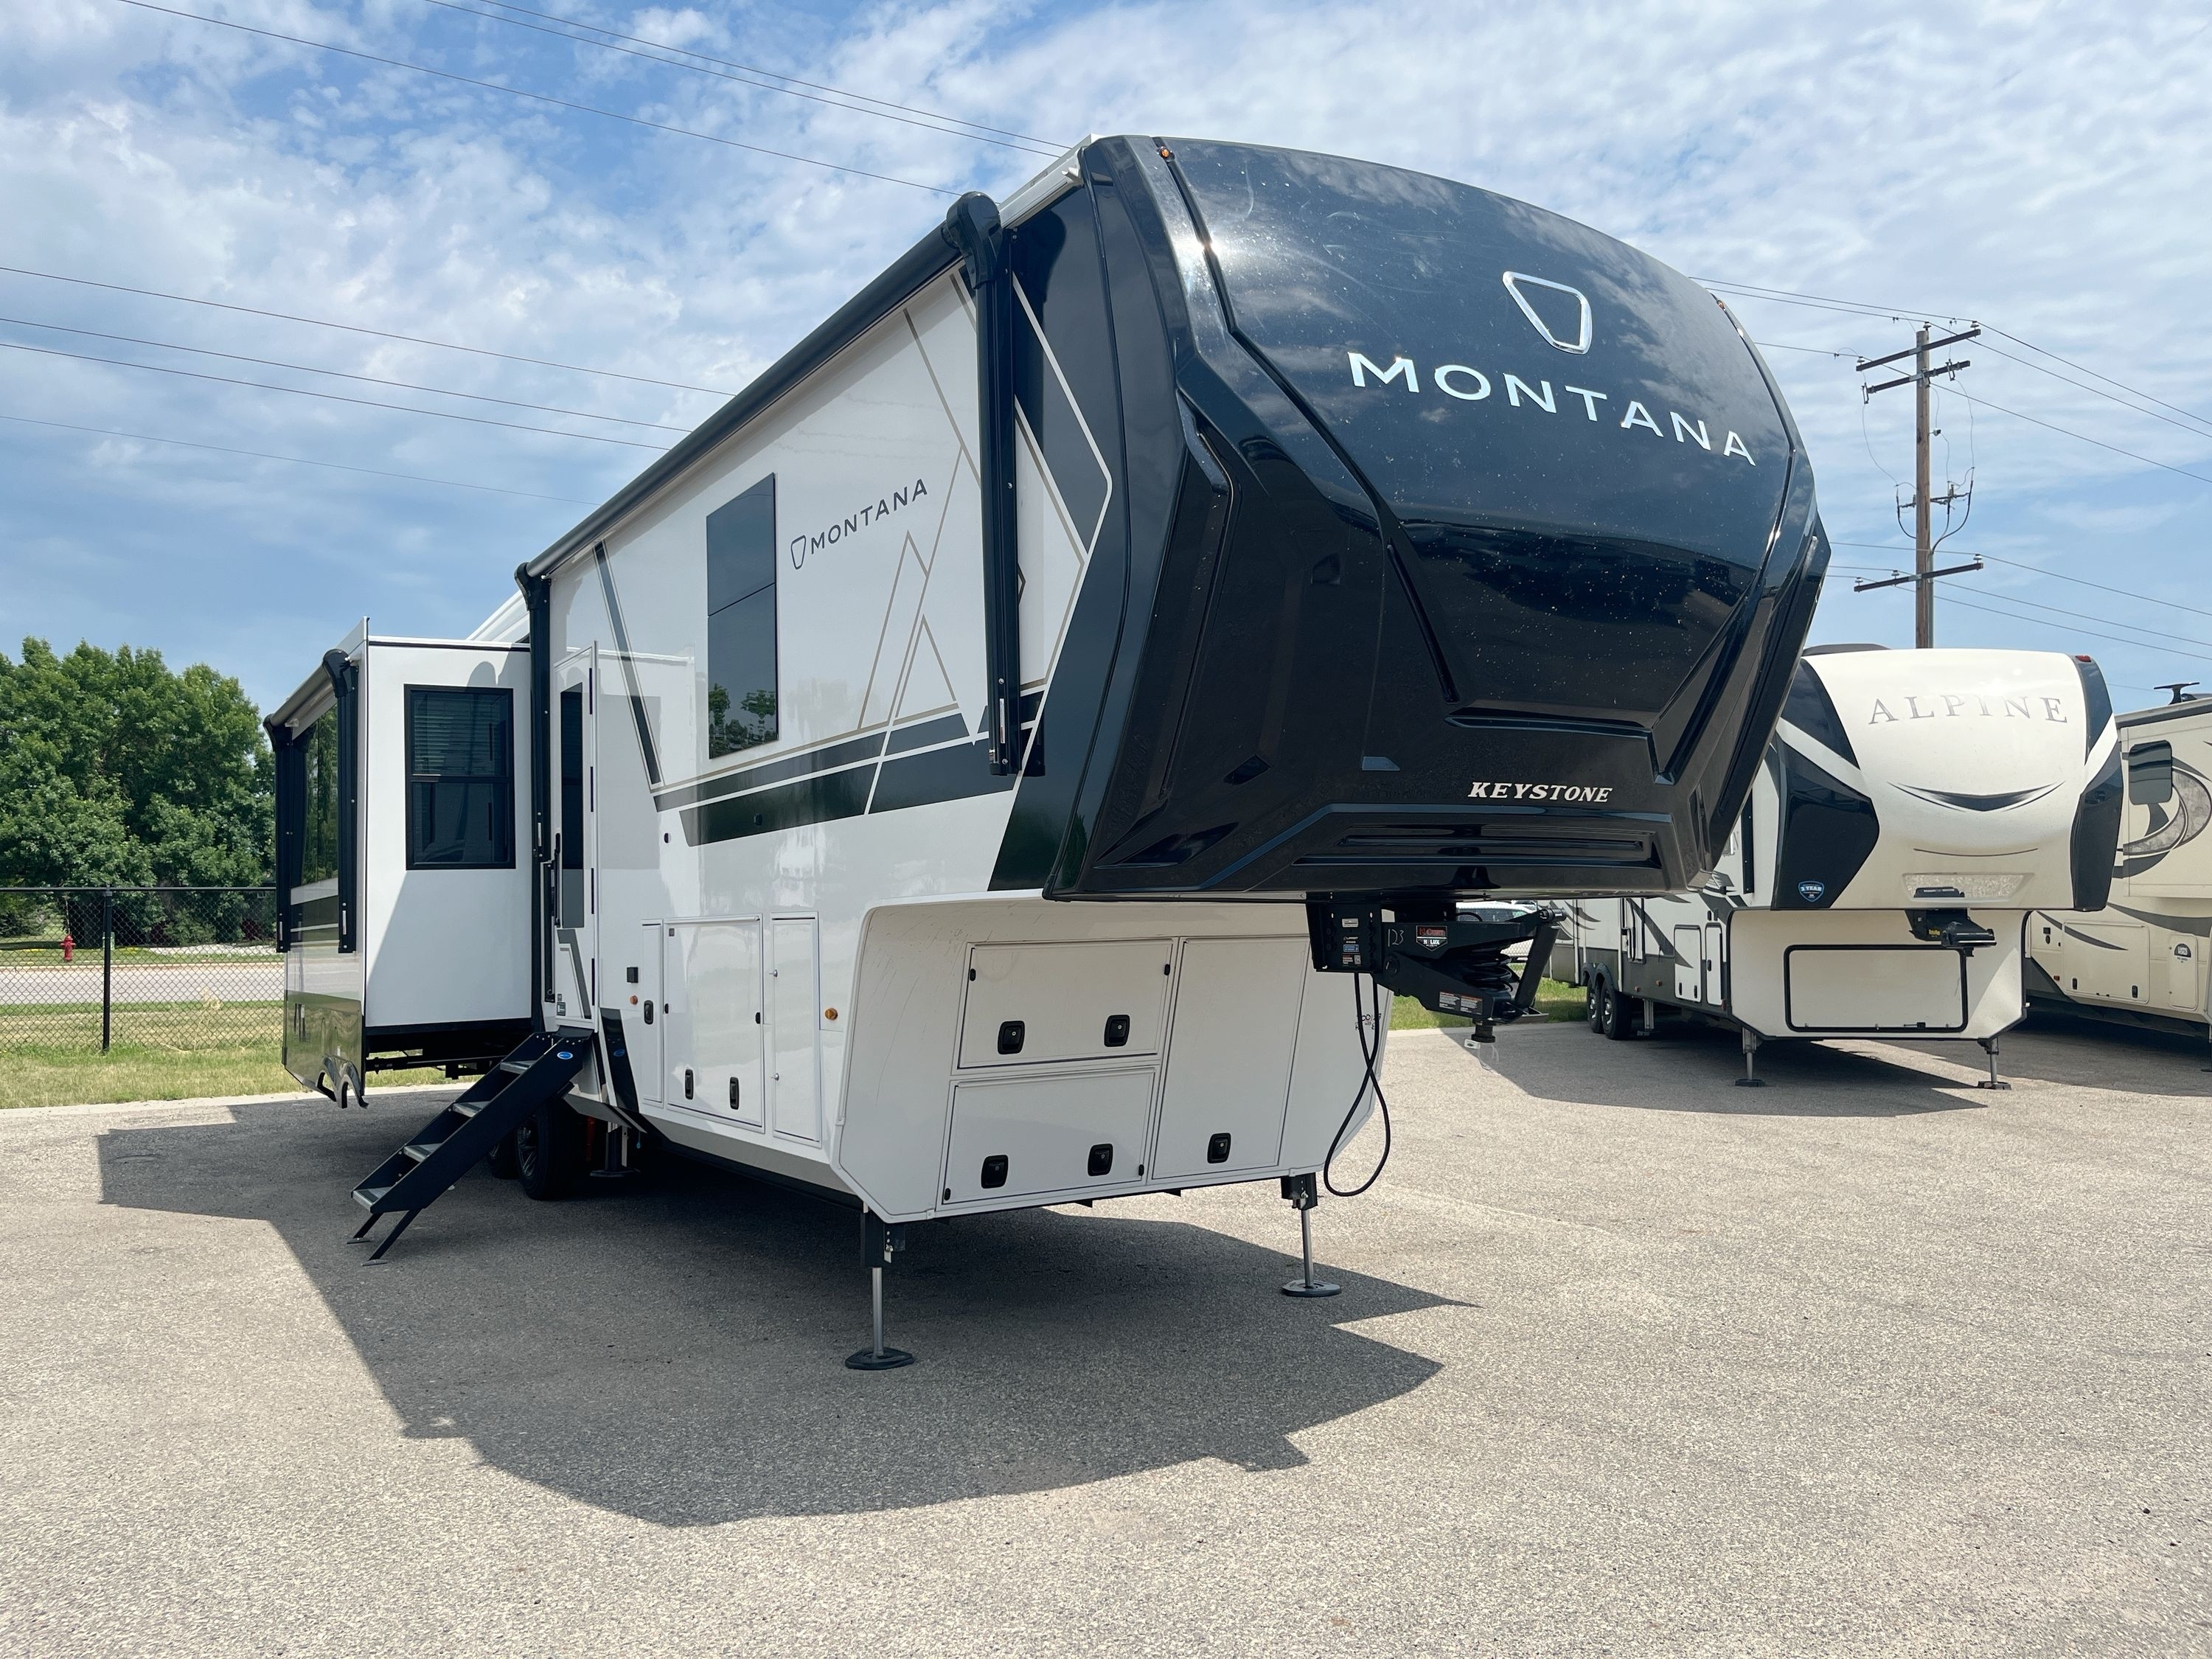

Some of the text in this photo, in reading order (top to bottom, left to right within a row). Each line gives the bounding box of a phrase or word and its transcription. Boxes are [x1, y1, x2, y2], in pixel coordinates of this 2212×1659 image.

[1347, 351, 1756, 467] MONTANA
[811, 478, 928, 554] MONTANA
[1868, 694, 2067, 725] ALPINE
[1467, 782, 1613, 803] KEYSTONE
[1387, 928, 1405, 947] 123
